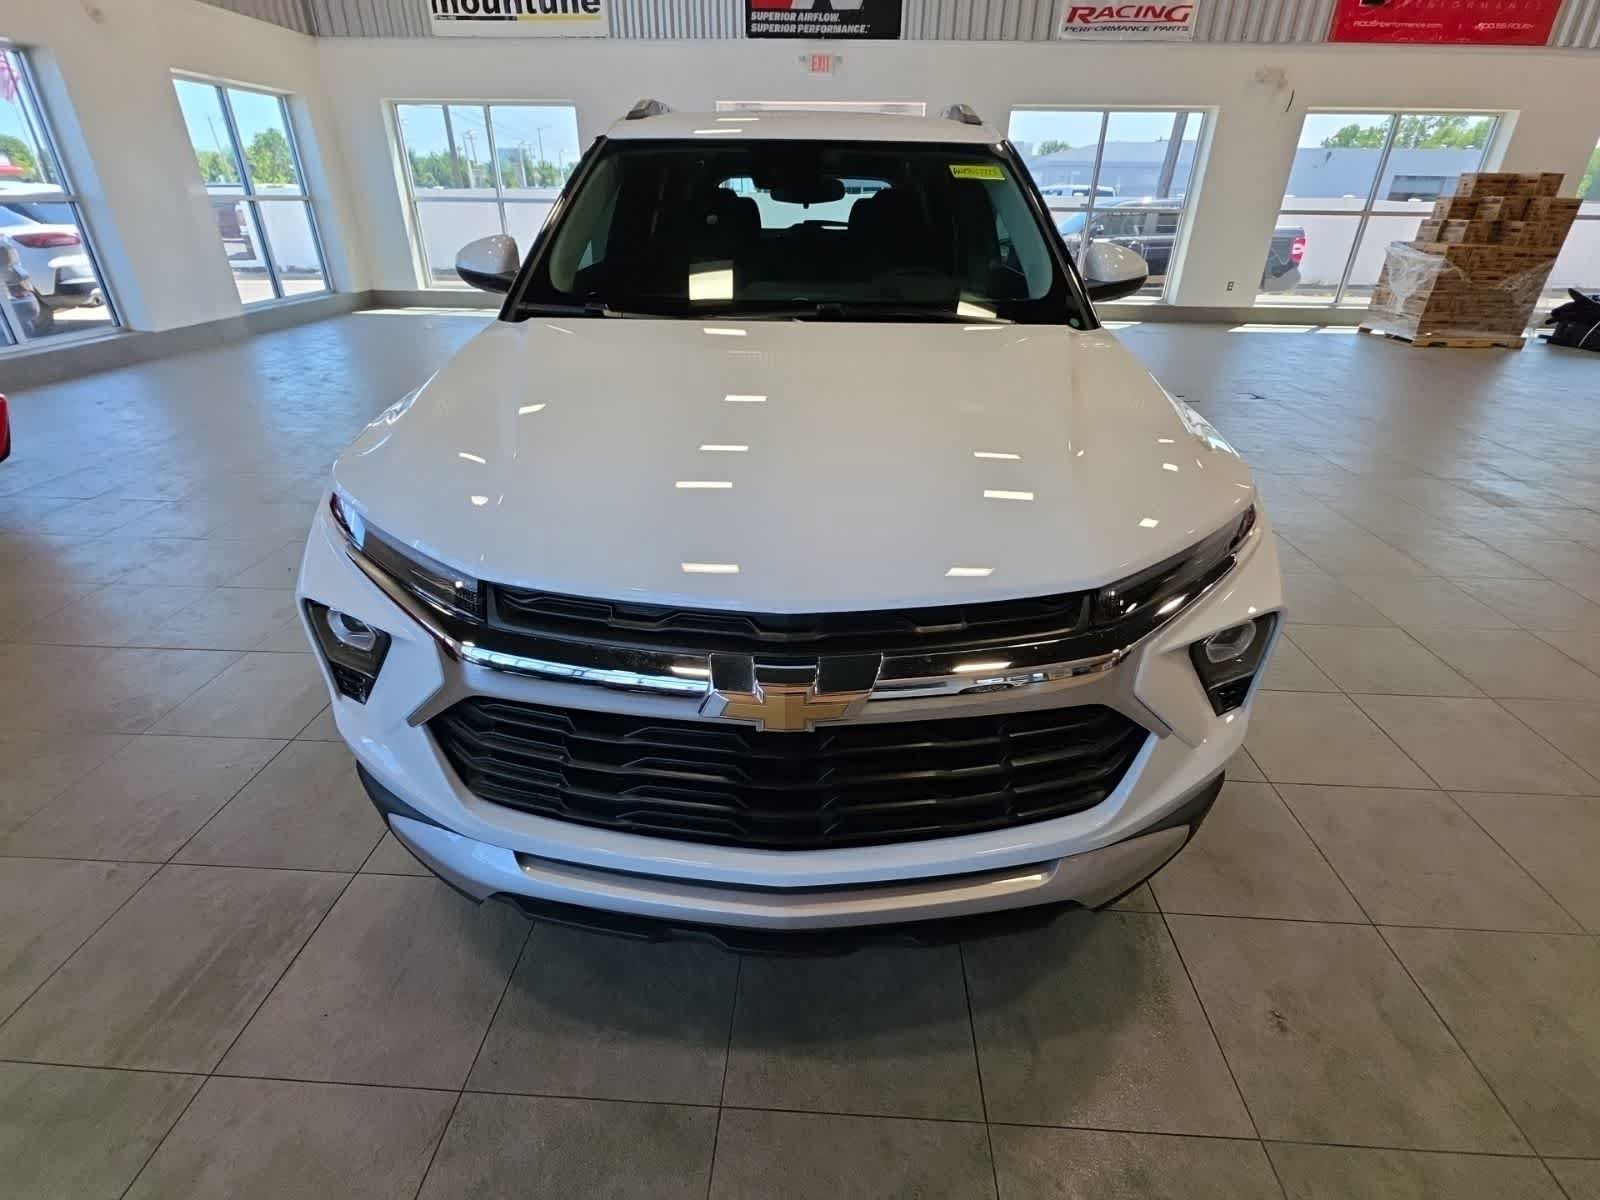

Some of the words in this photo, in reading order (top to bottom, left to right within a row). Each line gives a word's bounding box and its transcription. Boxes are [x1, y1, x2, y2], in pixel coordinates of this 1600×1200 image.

[751, 11, 797, 21] SUPERIOR
[797, 12, 840, 22] AIRFLOW.
[1066, 5, 1193, 23] RACING
[751, 23, 797, 32] SUPERIOR
[811, 54, 830, 72] EXIT
